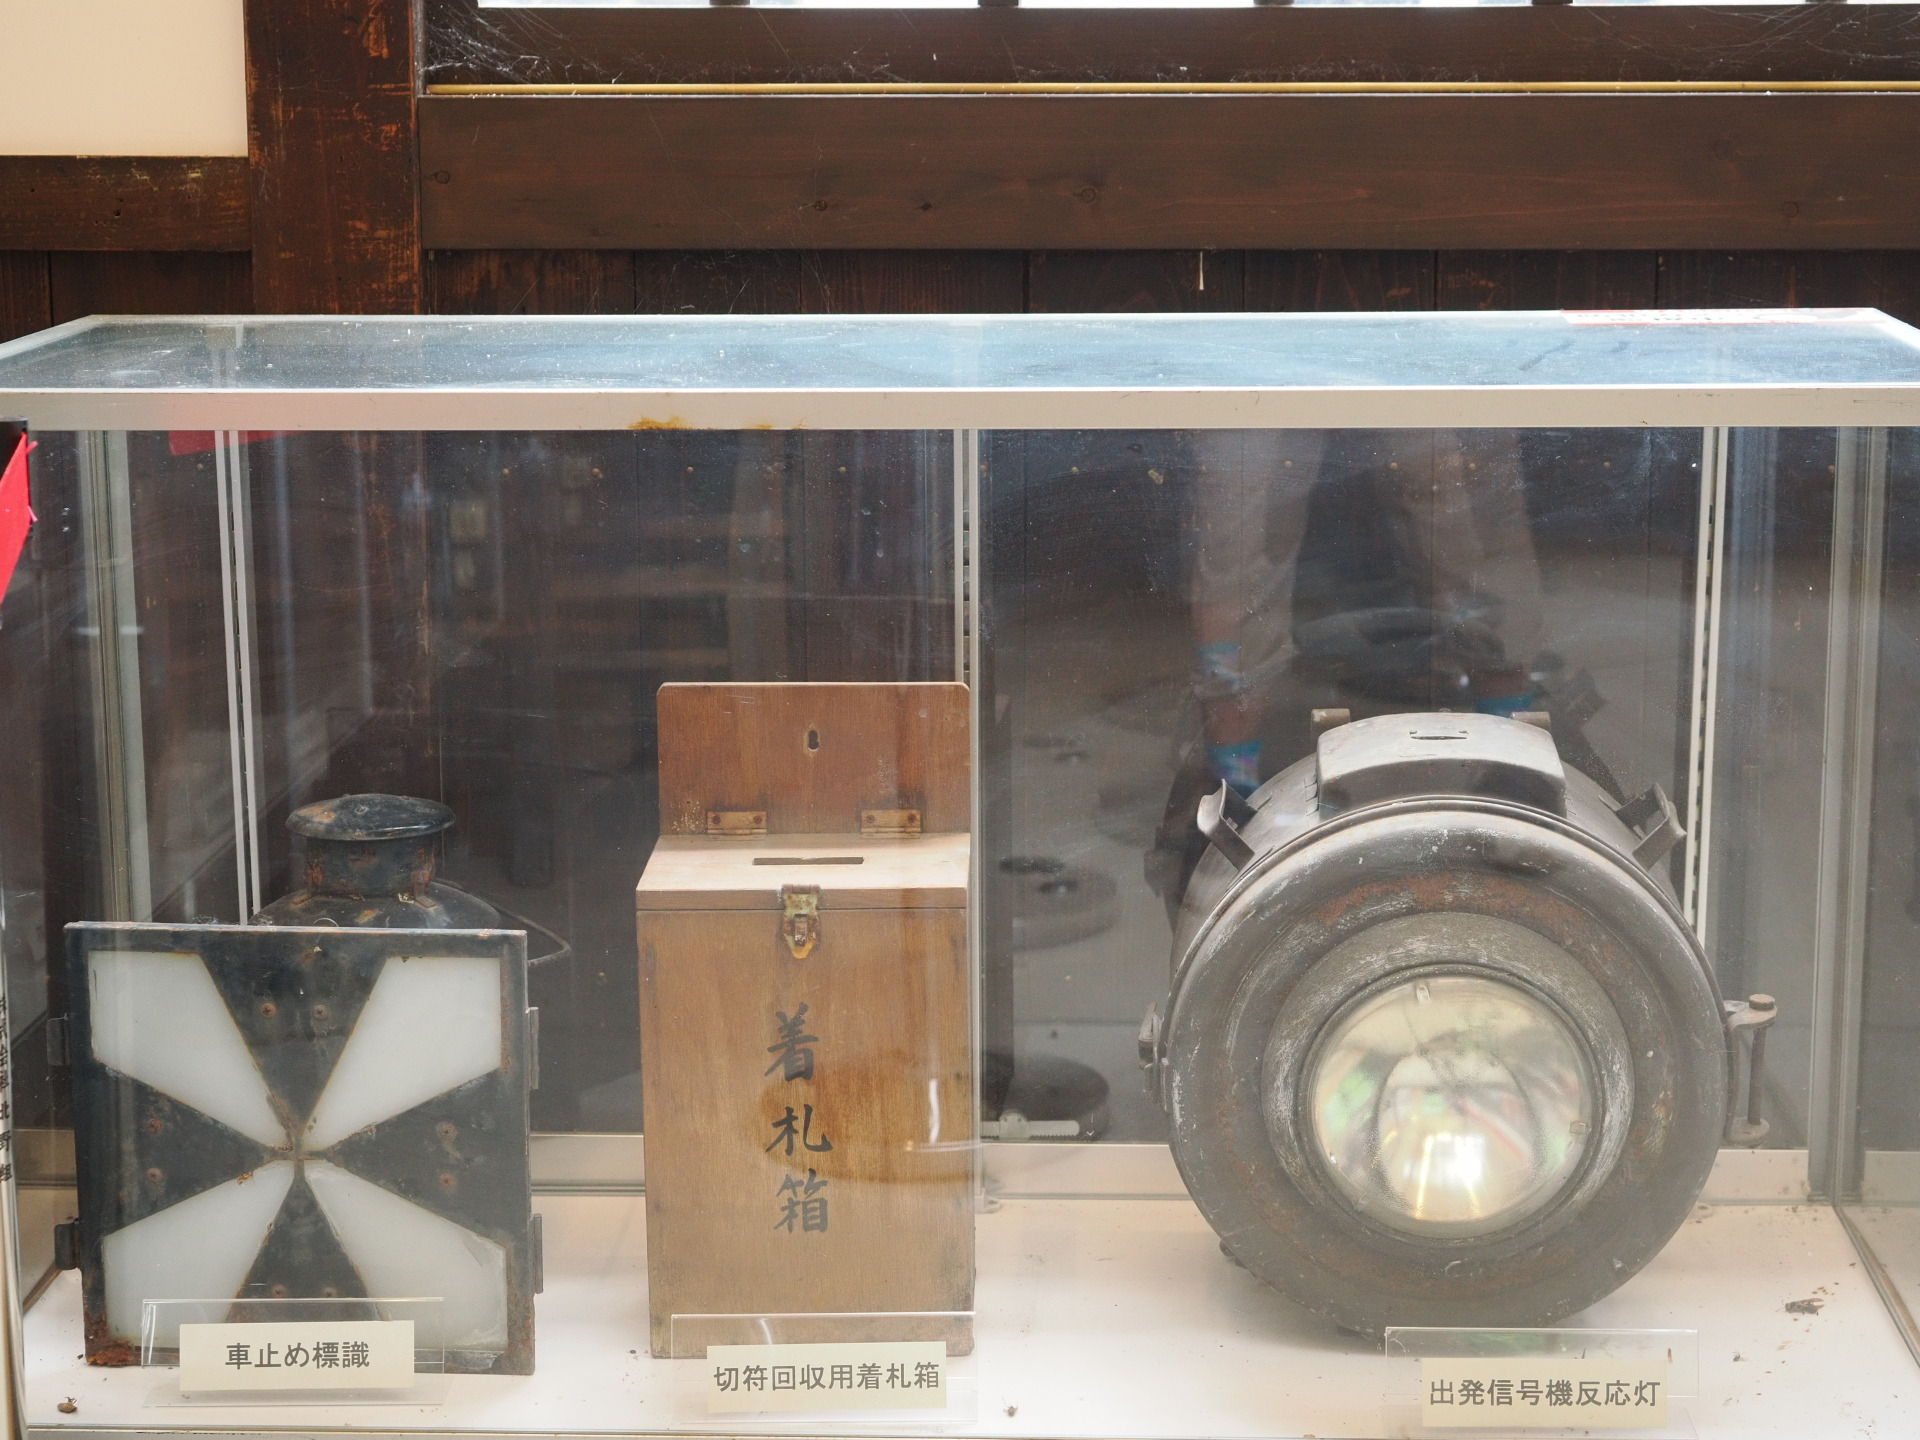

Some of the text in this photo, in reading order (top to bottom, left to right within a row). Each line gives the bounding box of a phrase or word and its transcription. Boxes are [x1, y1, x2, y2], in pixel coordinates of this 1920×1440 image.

[764, 1002, 834, 1234] 着札箱
[225, 1340, 370, 1370] 車止め標識
[713, 1361, 940, 1392] 切符回収用着札箱
[1429, 1378, 1661, 1407] 出発信号機反応灯
